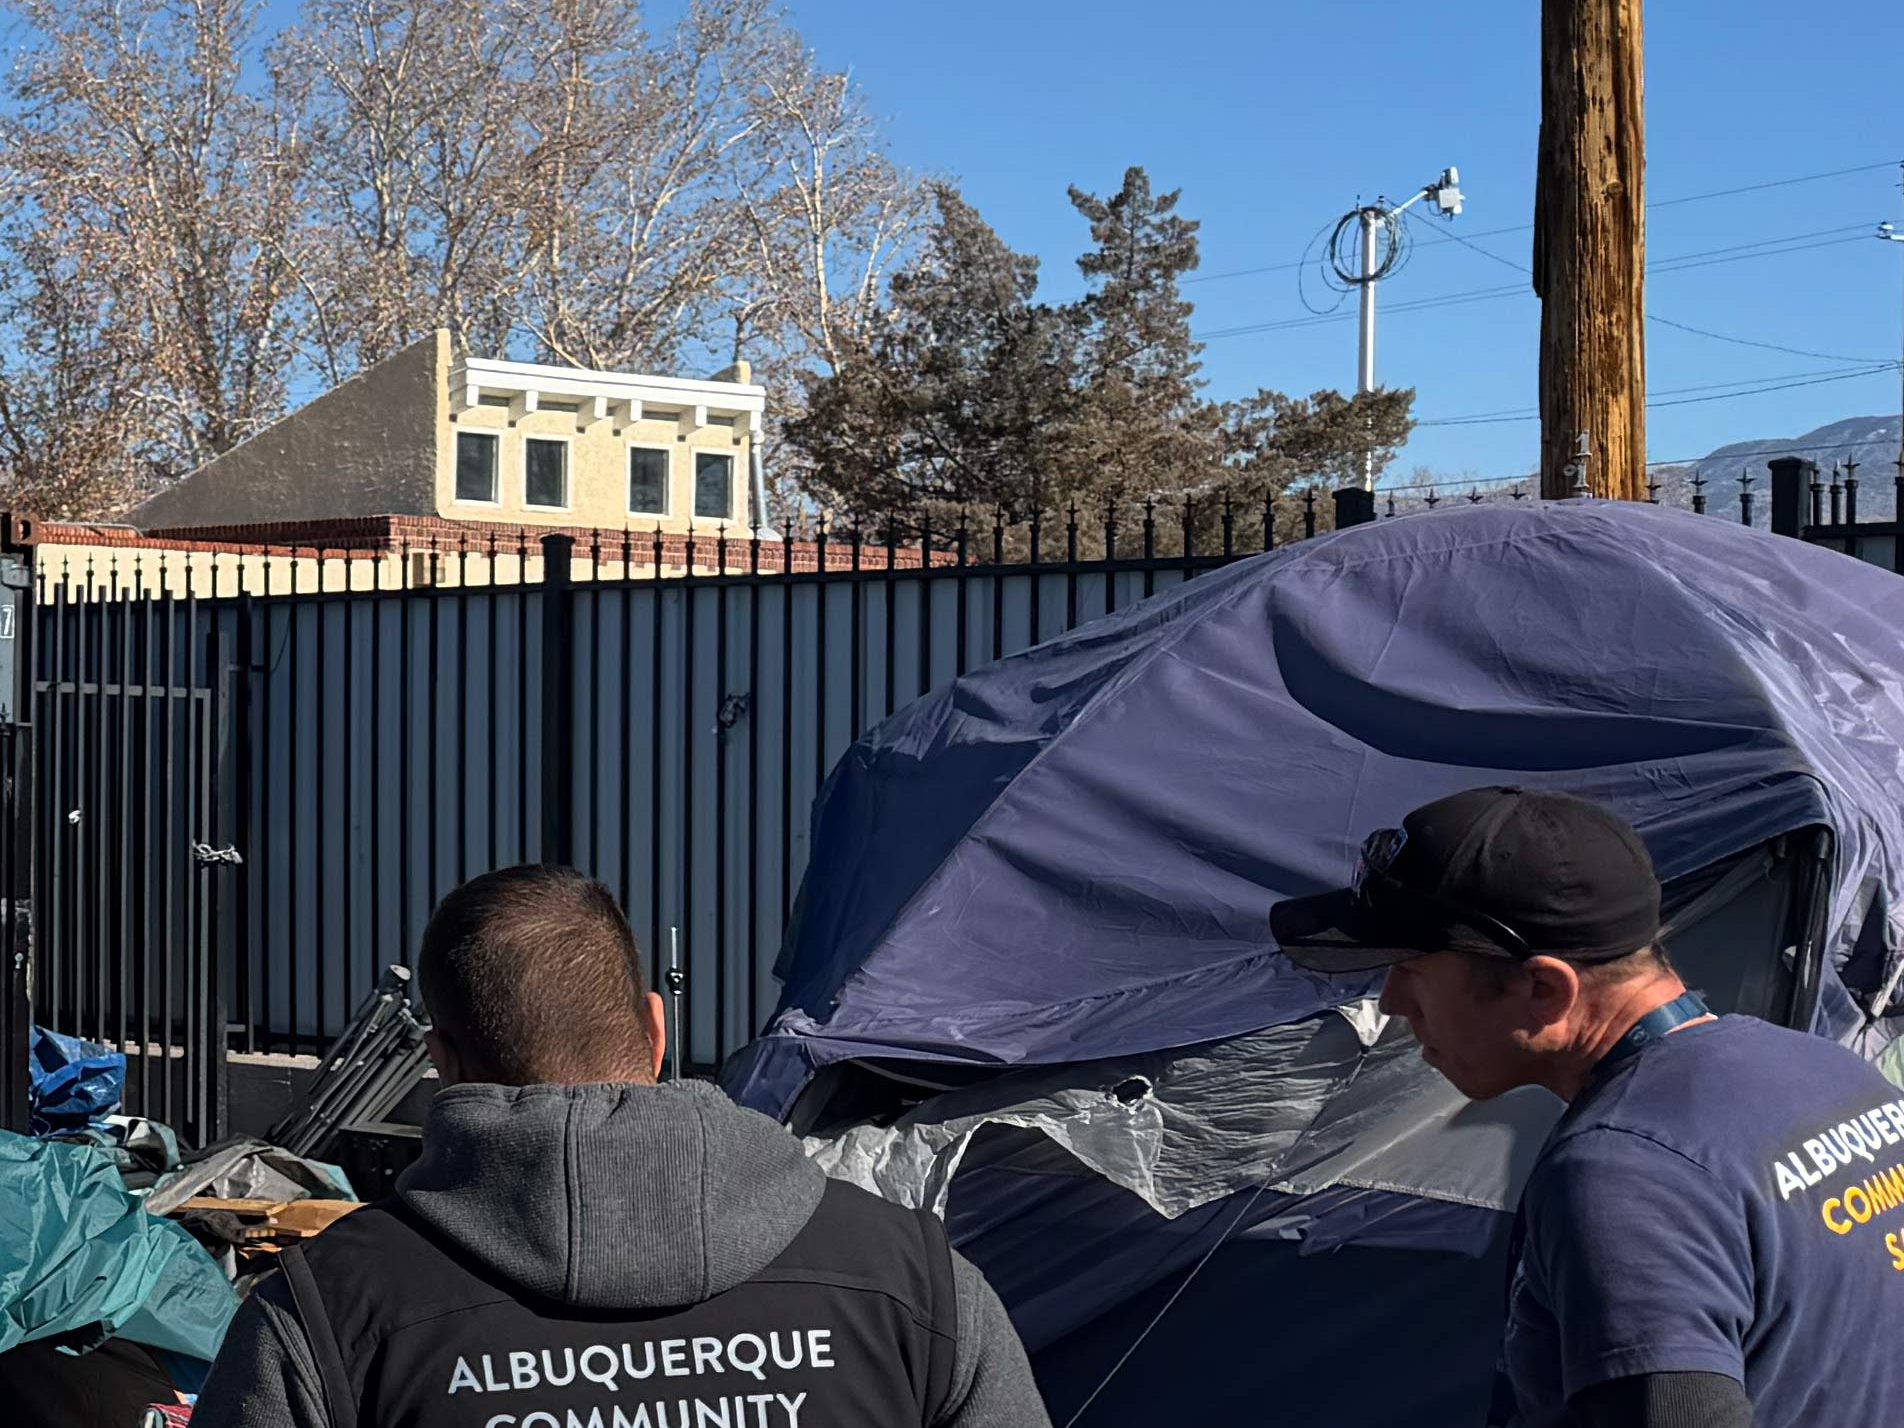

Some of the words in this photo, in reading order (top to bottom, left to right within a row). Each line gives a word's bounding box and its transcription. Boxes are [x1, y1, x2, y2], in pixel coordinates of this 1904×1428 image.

[1774, 1099, 1904, 1201] ALBUQUER
[1822, 1163, 1904, 1235] COMM
[1885, 1228, 1904, 1271] S
[447, 1329, 836, 1395] ALBUQUERQUE
